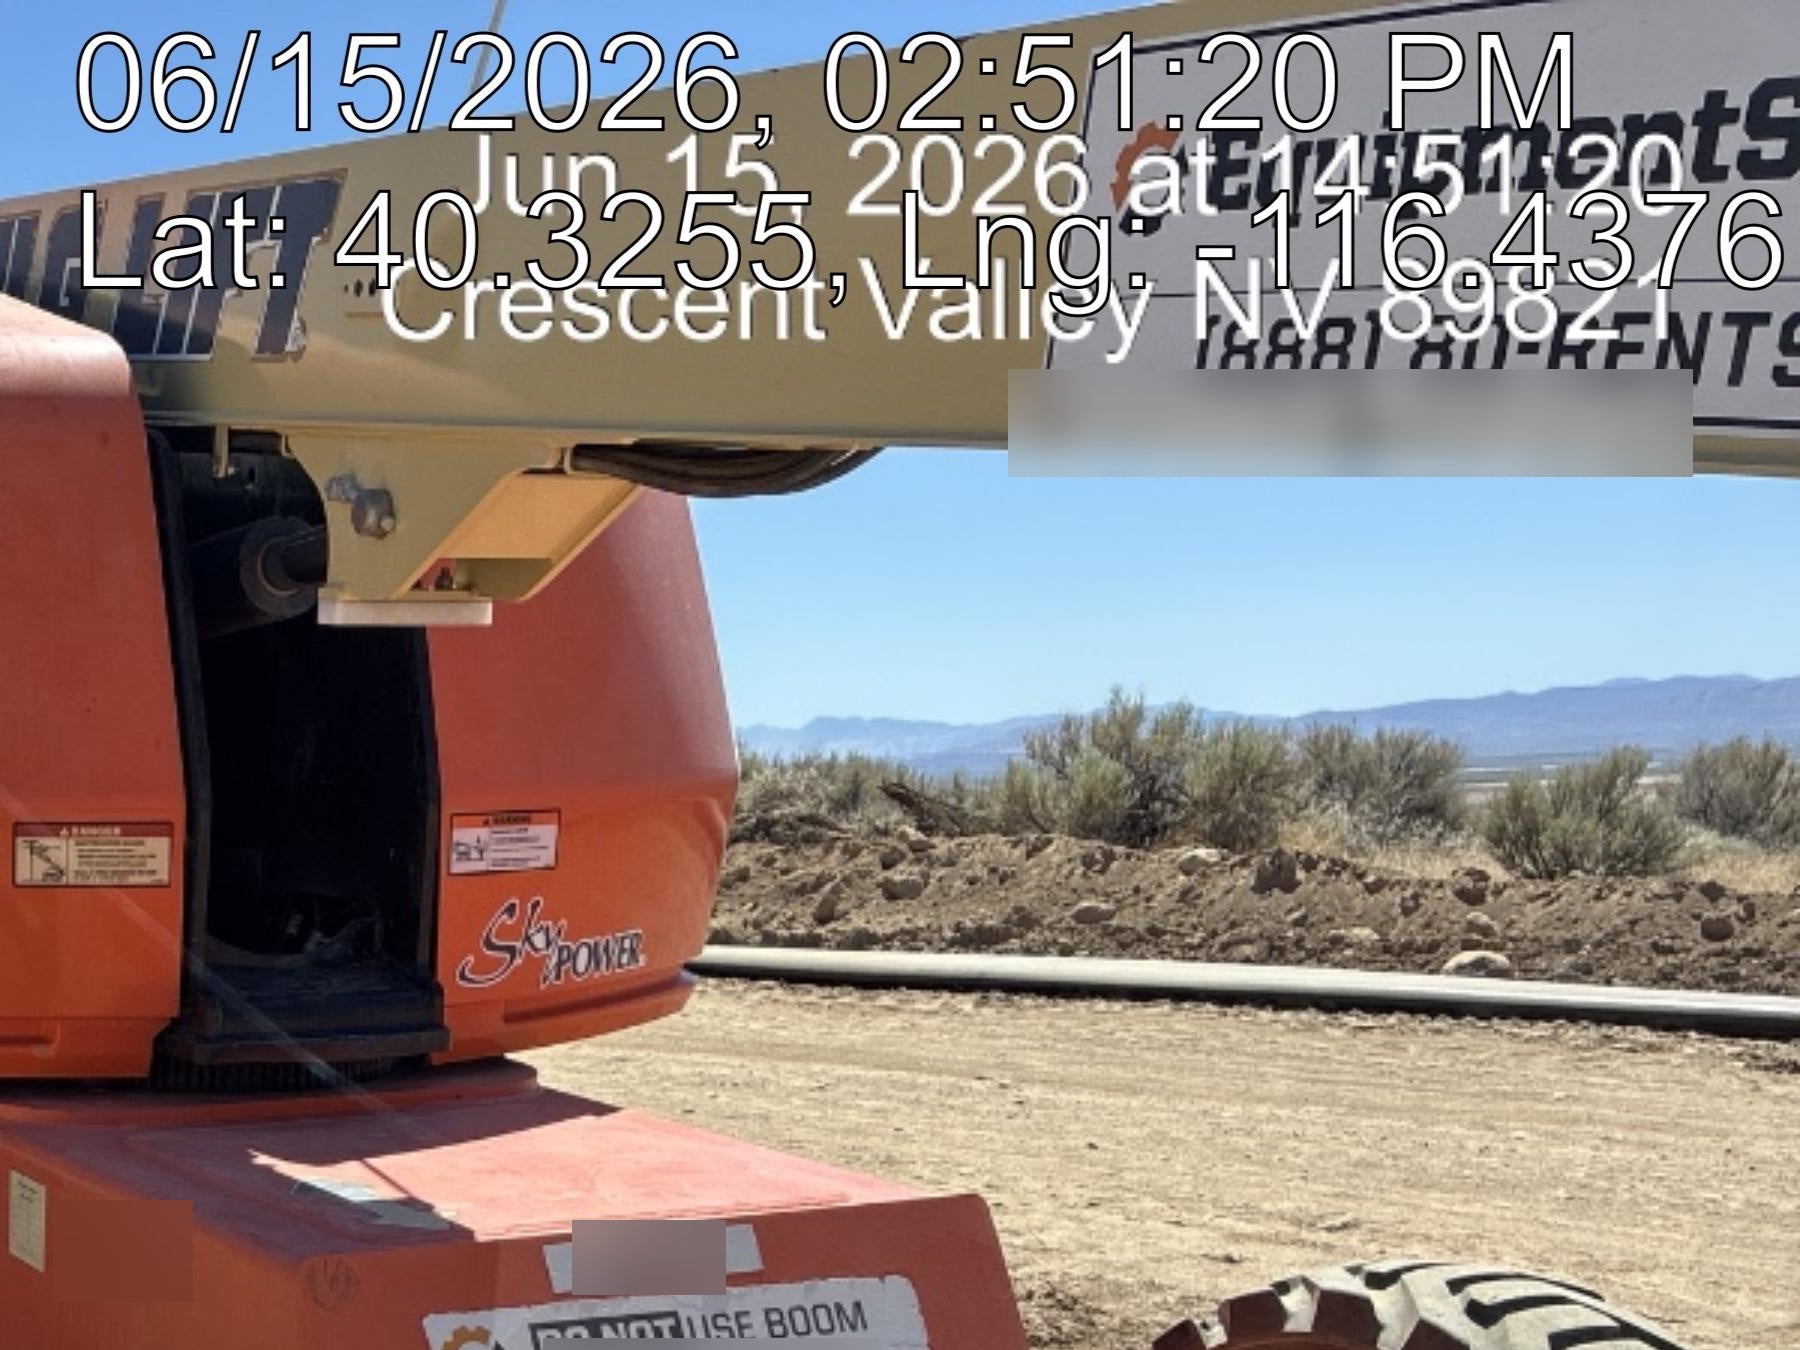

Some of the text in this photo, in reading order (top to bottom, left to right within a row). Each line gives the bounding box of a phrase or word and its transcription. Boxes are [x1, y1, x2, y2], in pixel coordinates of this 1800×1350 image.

[456, 896, 643, 990] Sky POWER
[763, 1300, 868, 1339] BOOM
